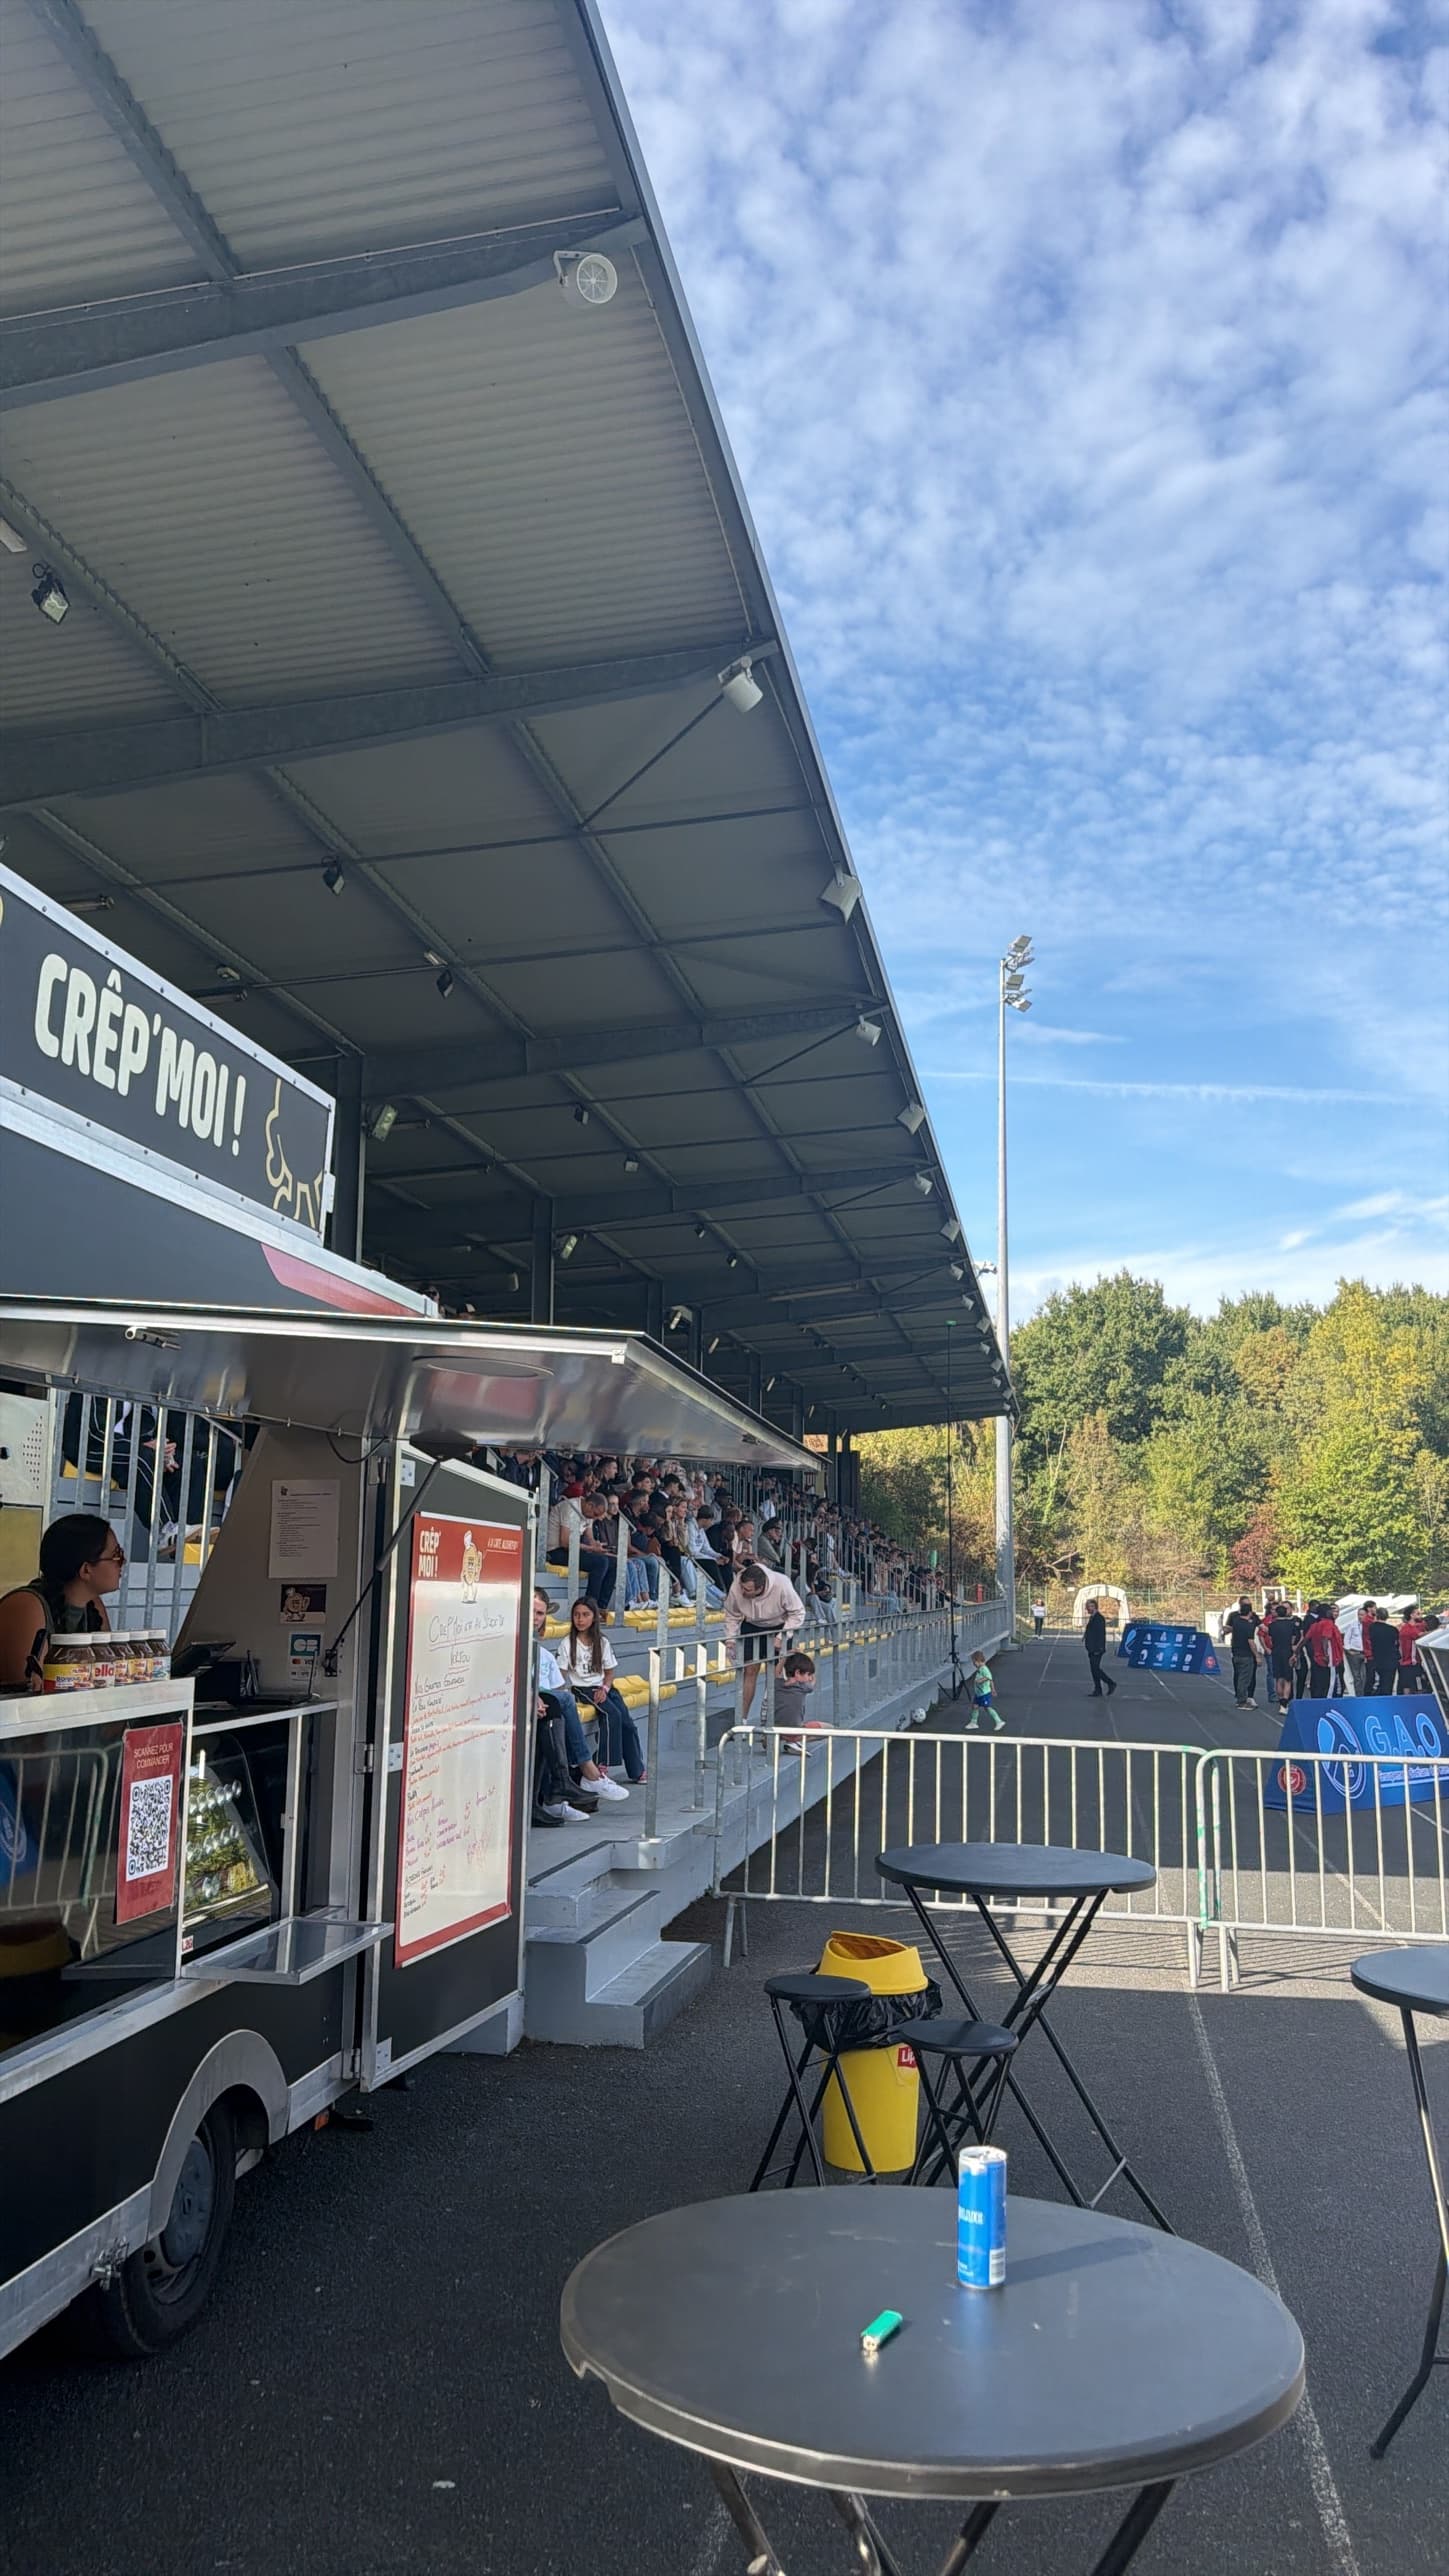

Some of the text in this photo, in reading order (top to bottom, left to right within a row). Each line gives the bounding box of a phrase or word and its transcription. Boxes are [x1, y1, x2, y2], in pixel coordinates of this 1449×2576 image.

[35, 953, 229, 1147] CRÊP'MOI
[158, 1742, 174, 1754] POUR
[136, 1754, 170, 1769] COMMANDER
